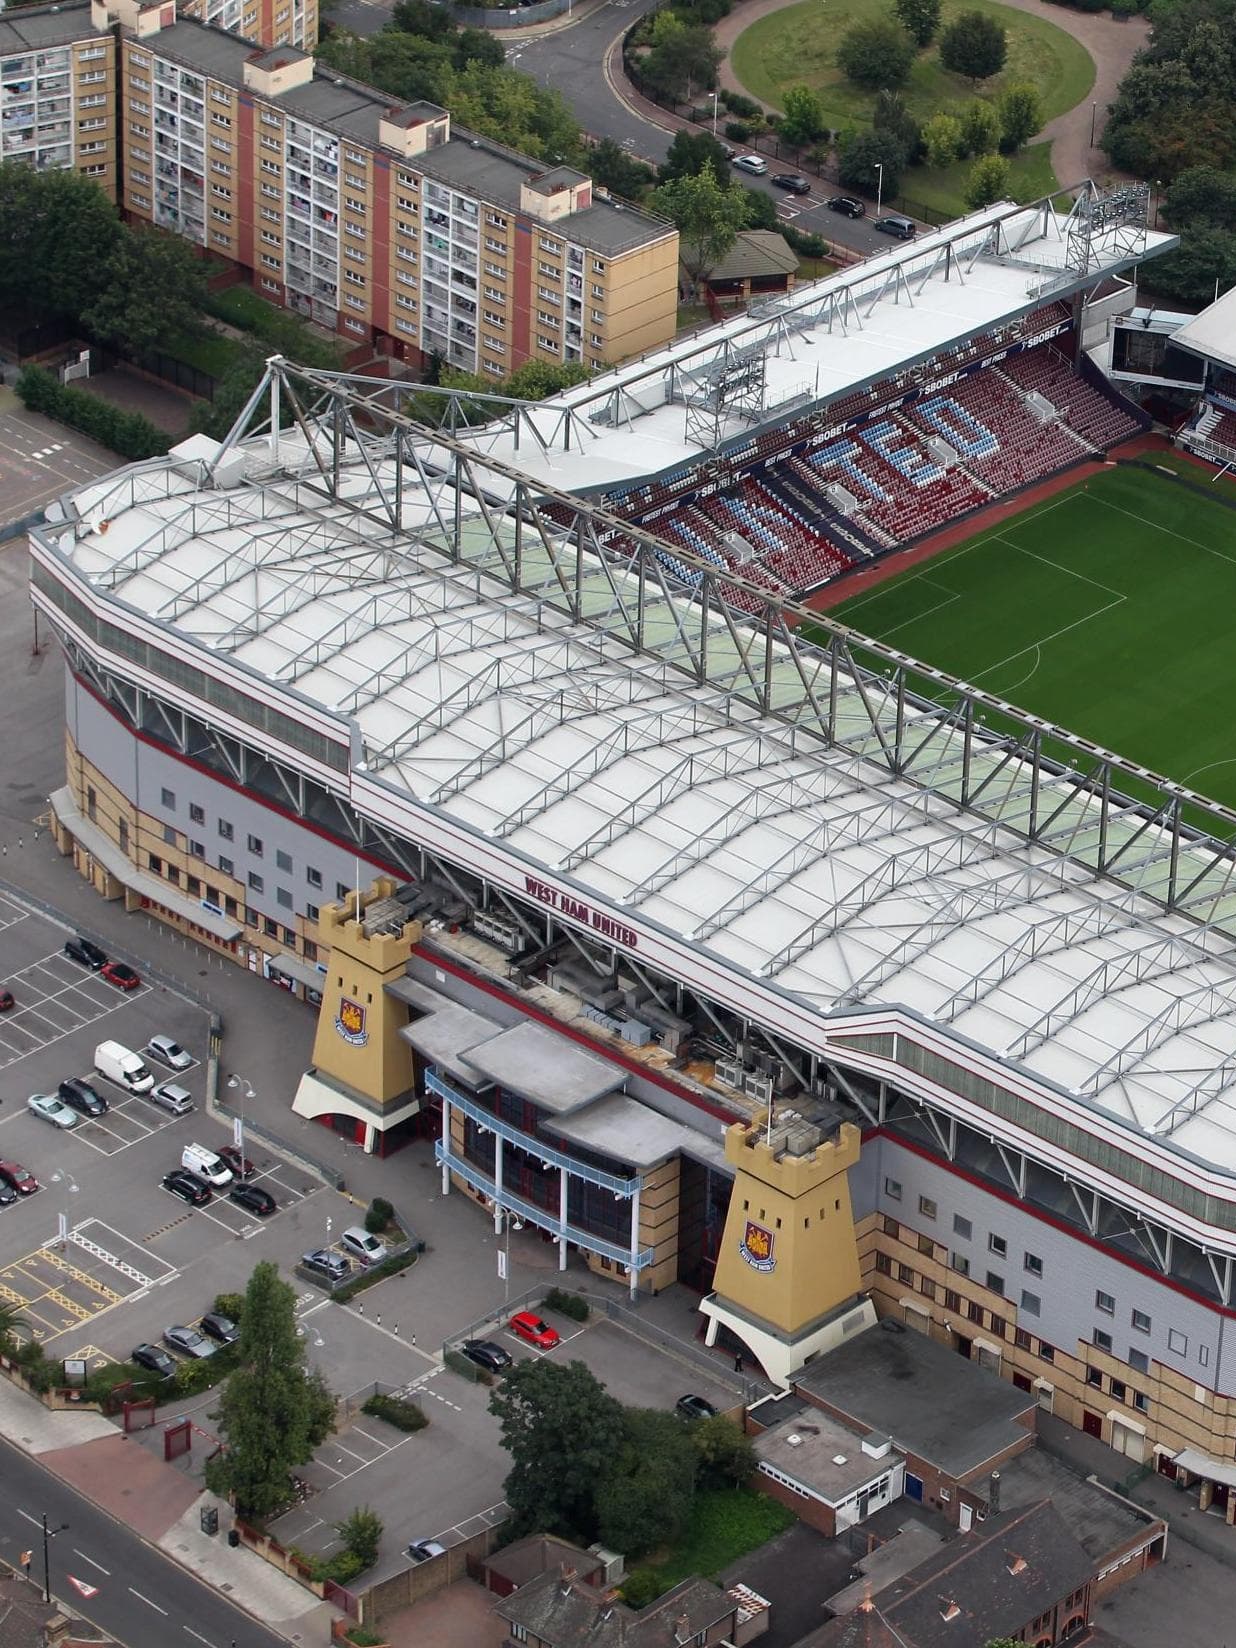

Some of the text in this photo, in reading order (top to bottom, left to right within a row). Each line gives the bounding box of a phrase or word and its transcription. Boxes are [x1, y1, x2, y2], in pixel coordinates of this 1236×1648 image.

[648, 396, 1000, 586] UNTED
[525, 876, 638, 947] WEST HAM UNITED
